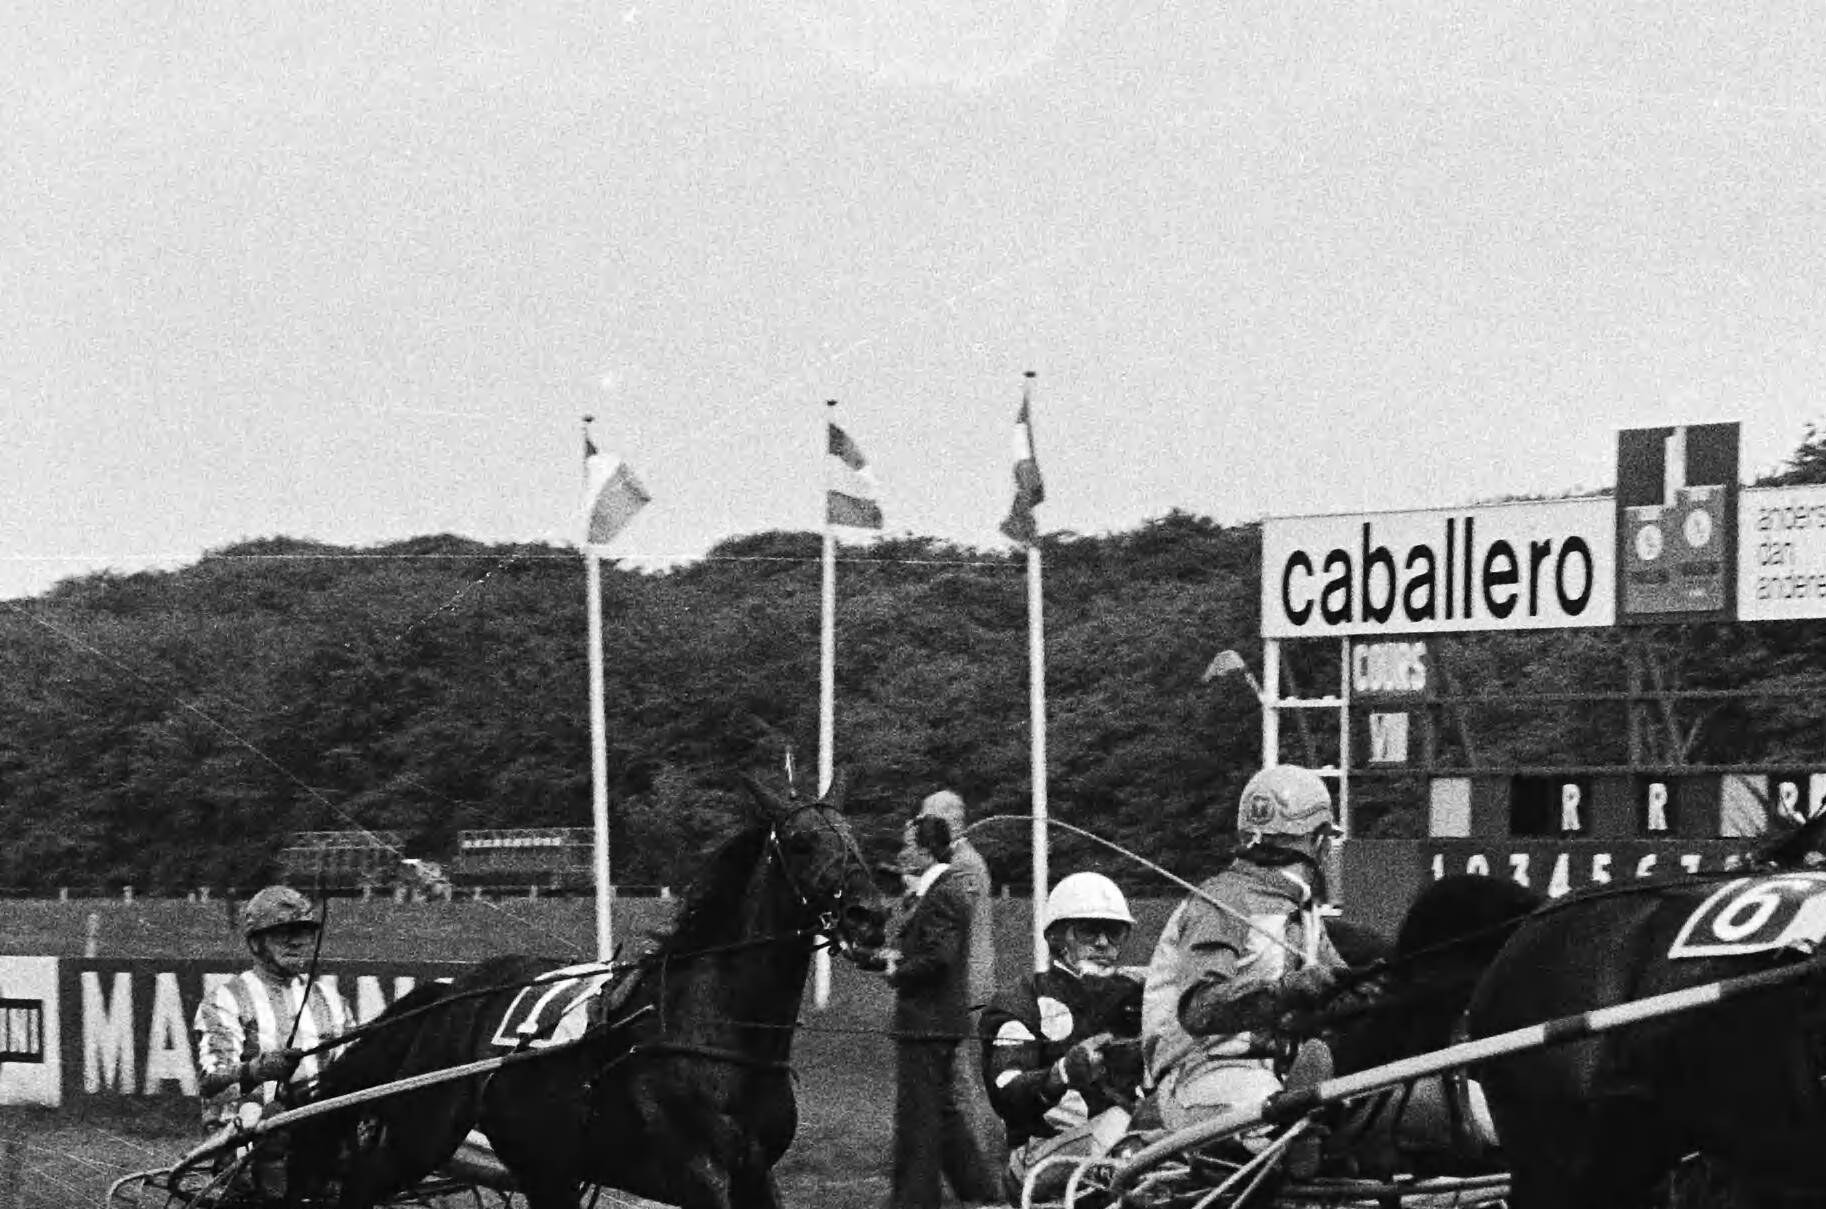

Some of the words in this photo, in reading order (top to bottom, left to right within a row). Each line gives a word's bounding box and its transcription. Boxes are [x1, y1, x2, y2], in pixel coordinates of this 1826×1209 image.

[1281, 517, 1594, 627] caballero
[1562, 784, 1581, 831] R
[1648, 783, 1668, 831] R
[1712, 879, 1815, 943] 6
